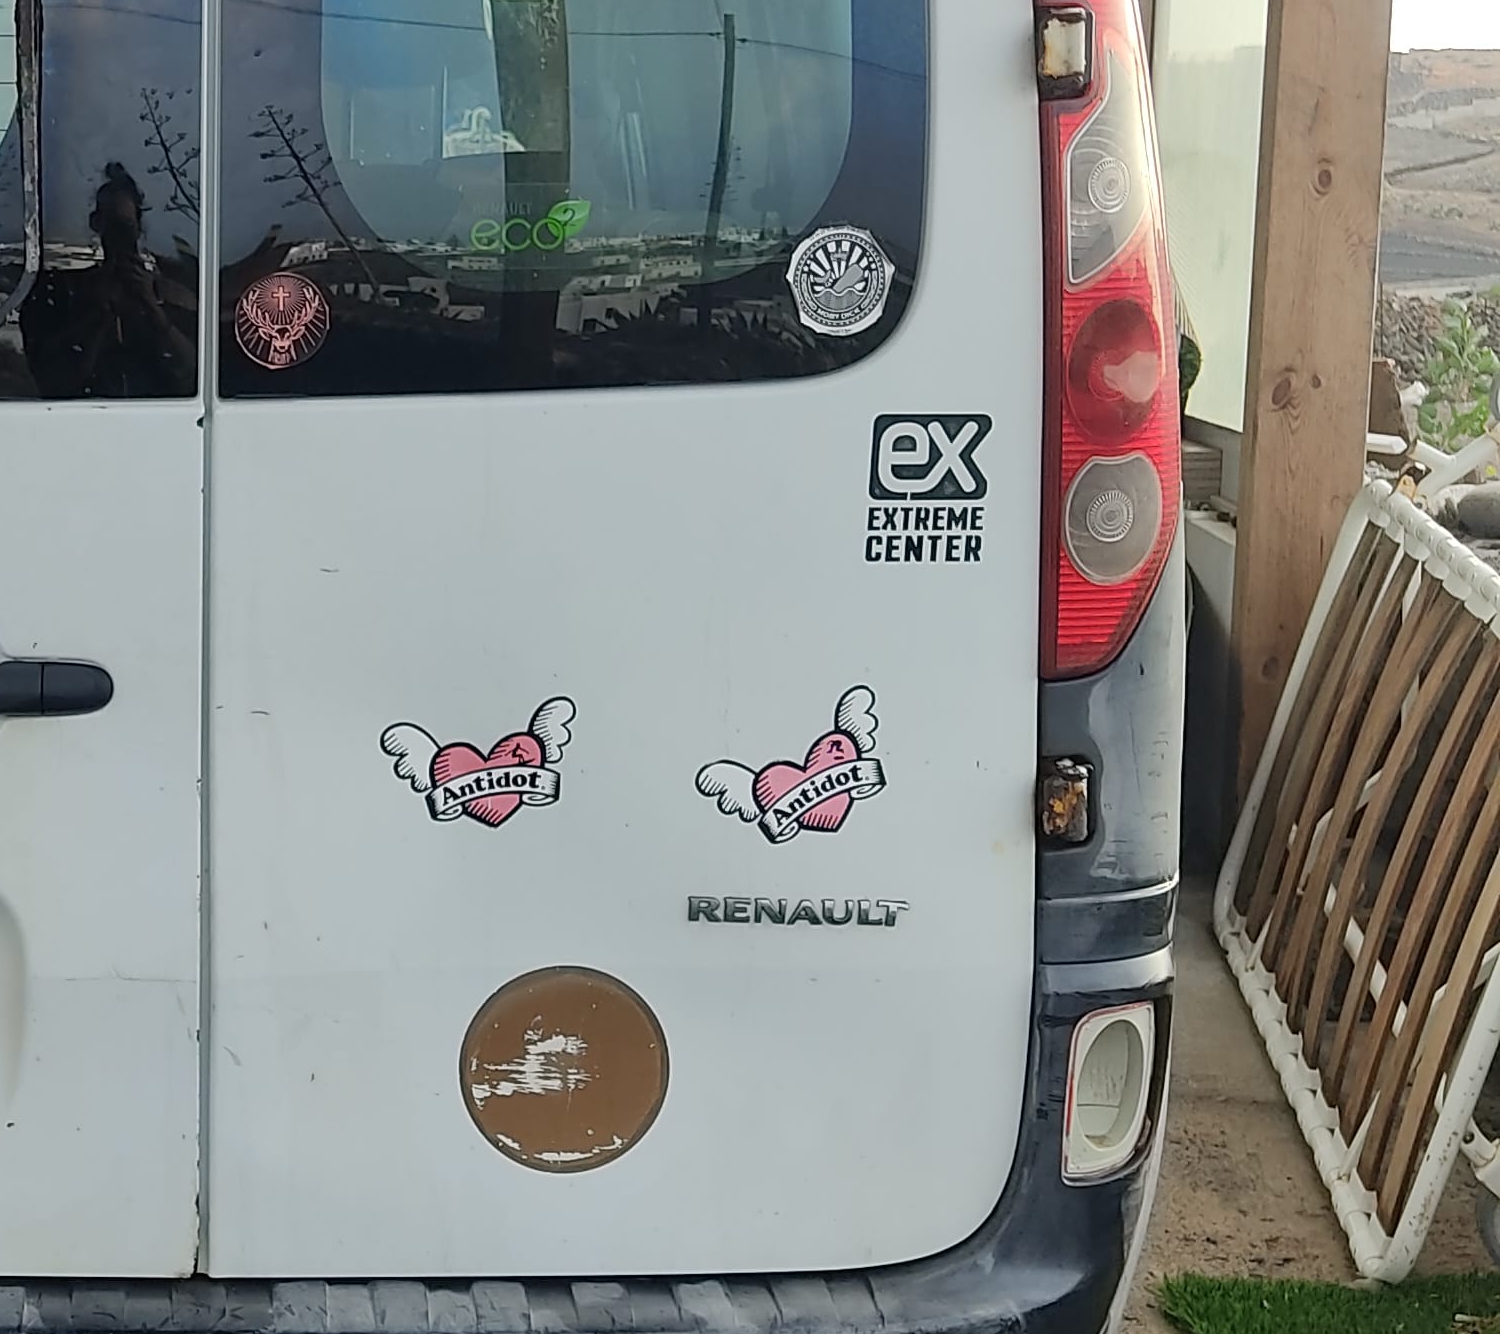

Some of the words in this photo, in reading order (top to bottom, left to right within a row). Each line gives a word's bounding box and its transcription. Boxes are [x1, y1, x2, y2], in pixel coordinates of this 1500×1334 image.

[867, 506, 984, 531] EXTREME
[865, 535, 982, 562] CENTER
[443, 771, 541, 806] Antidot
[772, 765, 863, 827] Antidot
[688, 896, 910, 927] RENAULT
